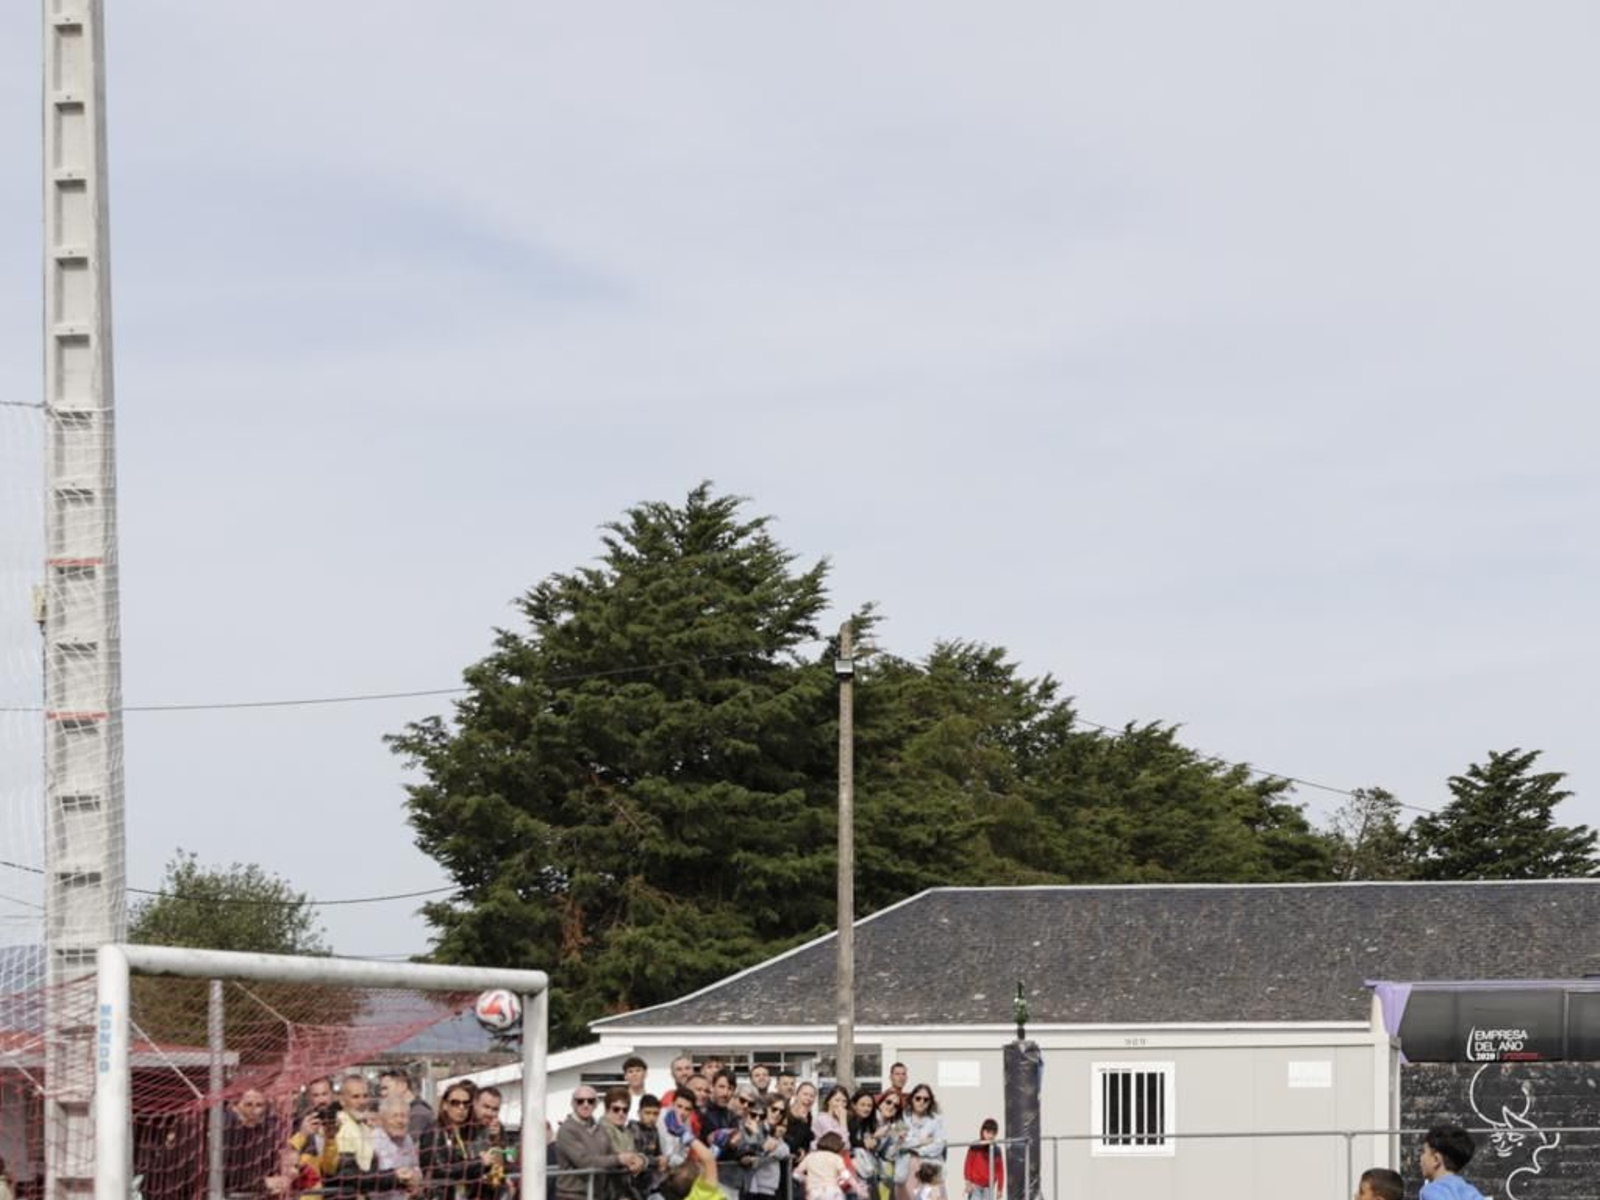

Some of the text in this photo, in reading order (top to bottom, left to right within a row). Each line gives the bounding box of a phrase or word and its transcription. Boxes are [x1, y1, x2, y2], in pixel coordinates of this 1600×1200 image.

[99, 1004, 112, 1073] MONDO
[1474, 1029, 1529, 1041] EMPRESA
[1474, 1039, 1524, 1052] DEL AÑO
